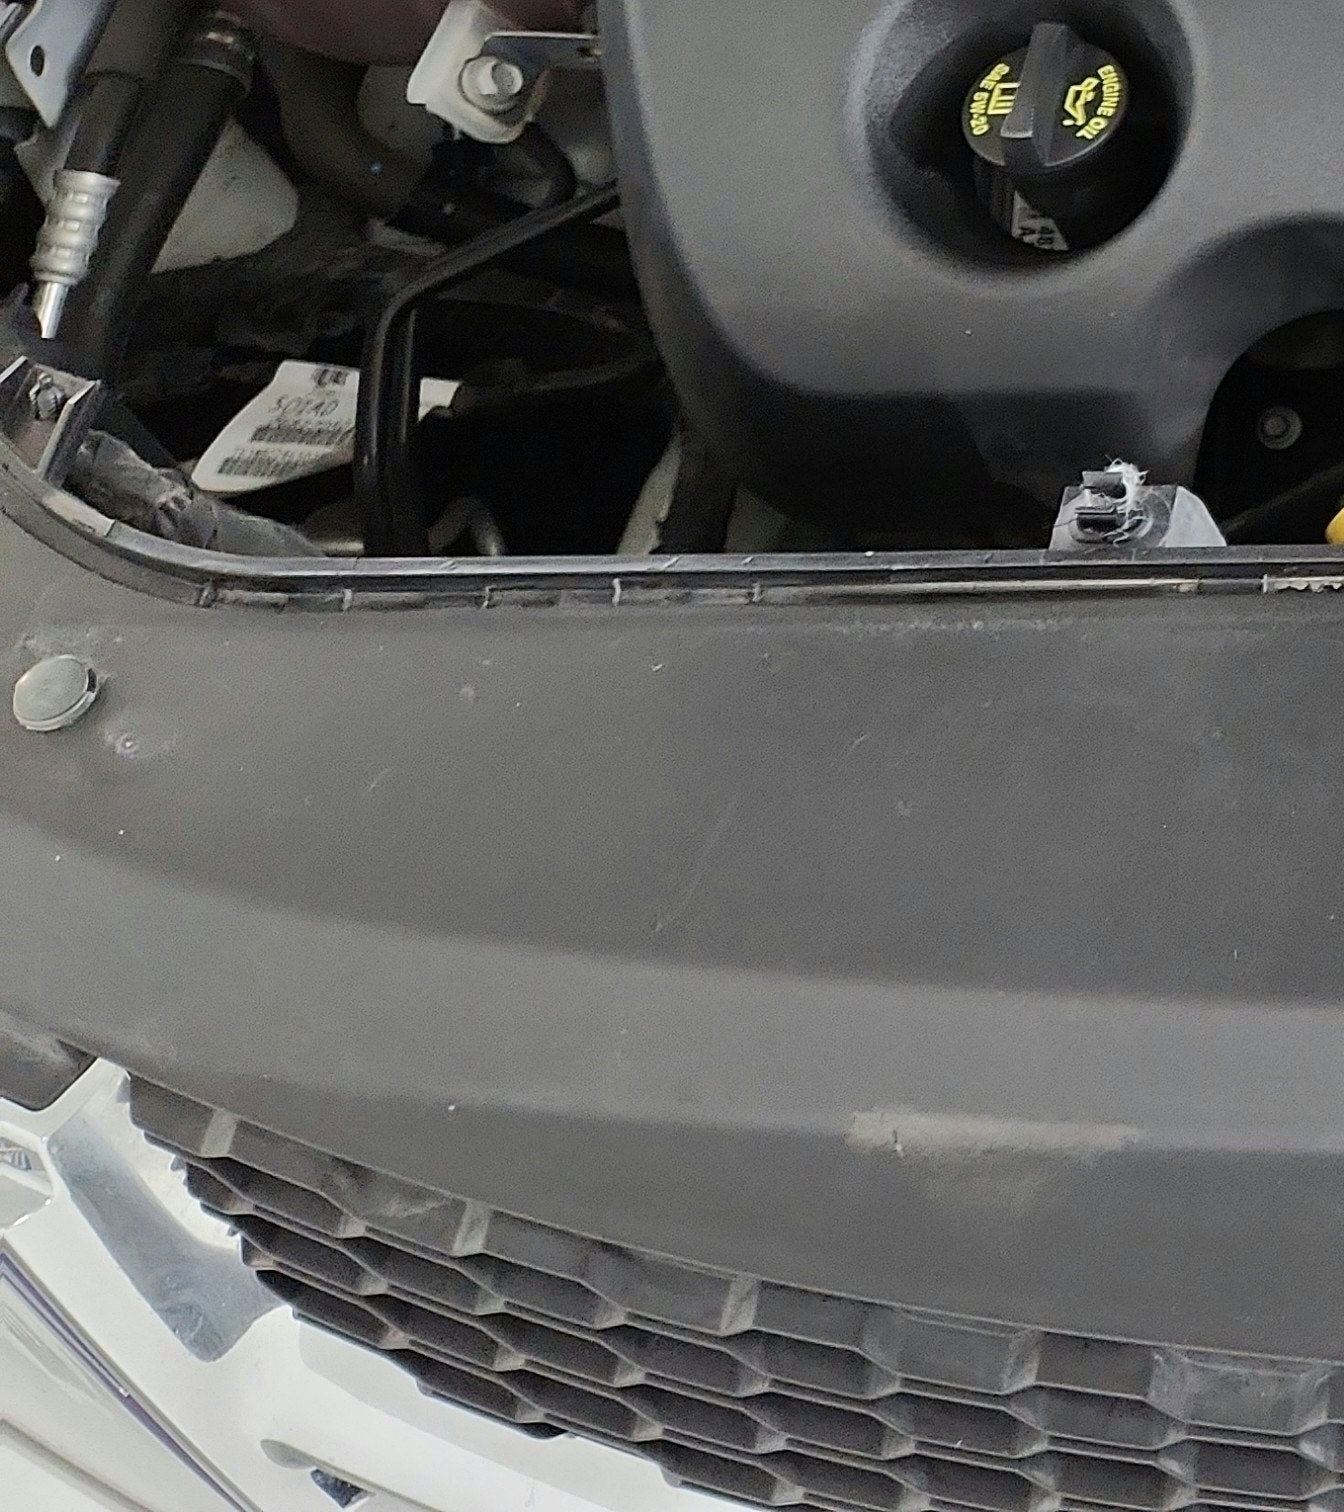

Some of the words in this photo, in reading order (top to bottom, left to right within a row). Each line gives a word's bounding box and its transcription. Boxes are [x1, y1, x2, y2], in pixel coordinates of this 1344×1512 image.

[979, 63, 1010, 90] SAE
[1097, 64, 1121, 117] ENGINE
[1076, 116, 1109, 140] OIL
